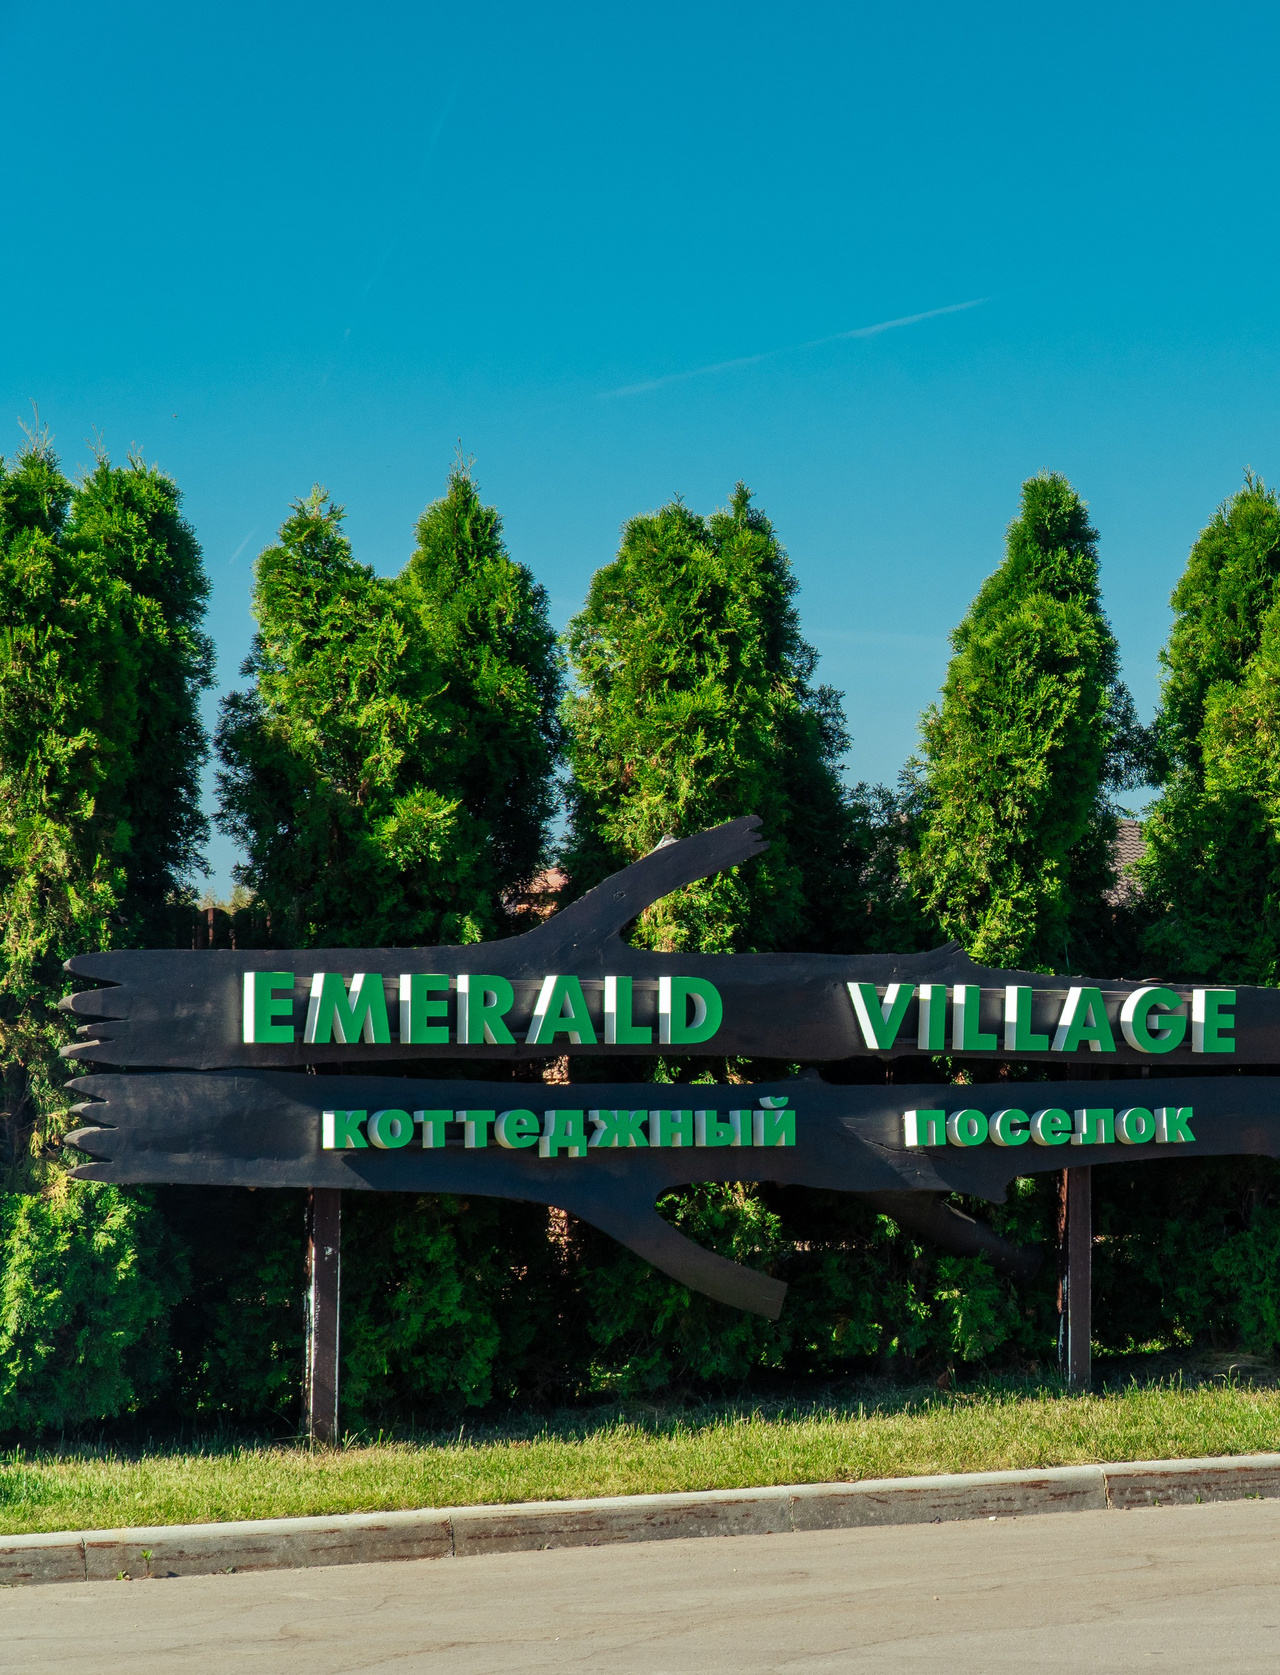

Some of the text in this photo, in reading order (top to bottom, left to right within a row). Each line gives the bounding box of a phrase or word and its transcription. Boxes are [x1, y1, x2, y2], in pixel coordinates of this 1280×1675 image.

[243, 972, 1236, 1054] EMERALD VILLAGE
[322, 1096, 1196, 1158] коттеджный поселок
